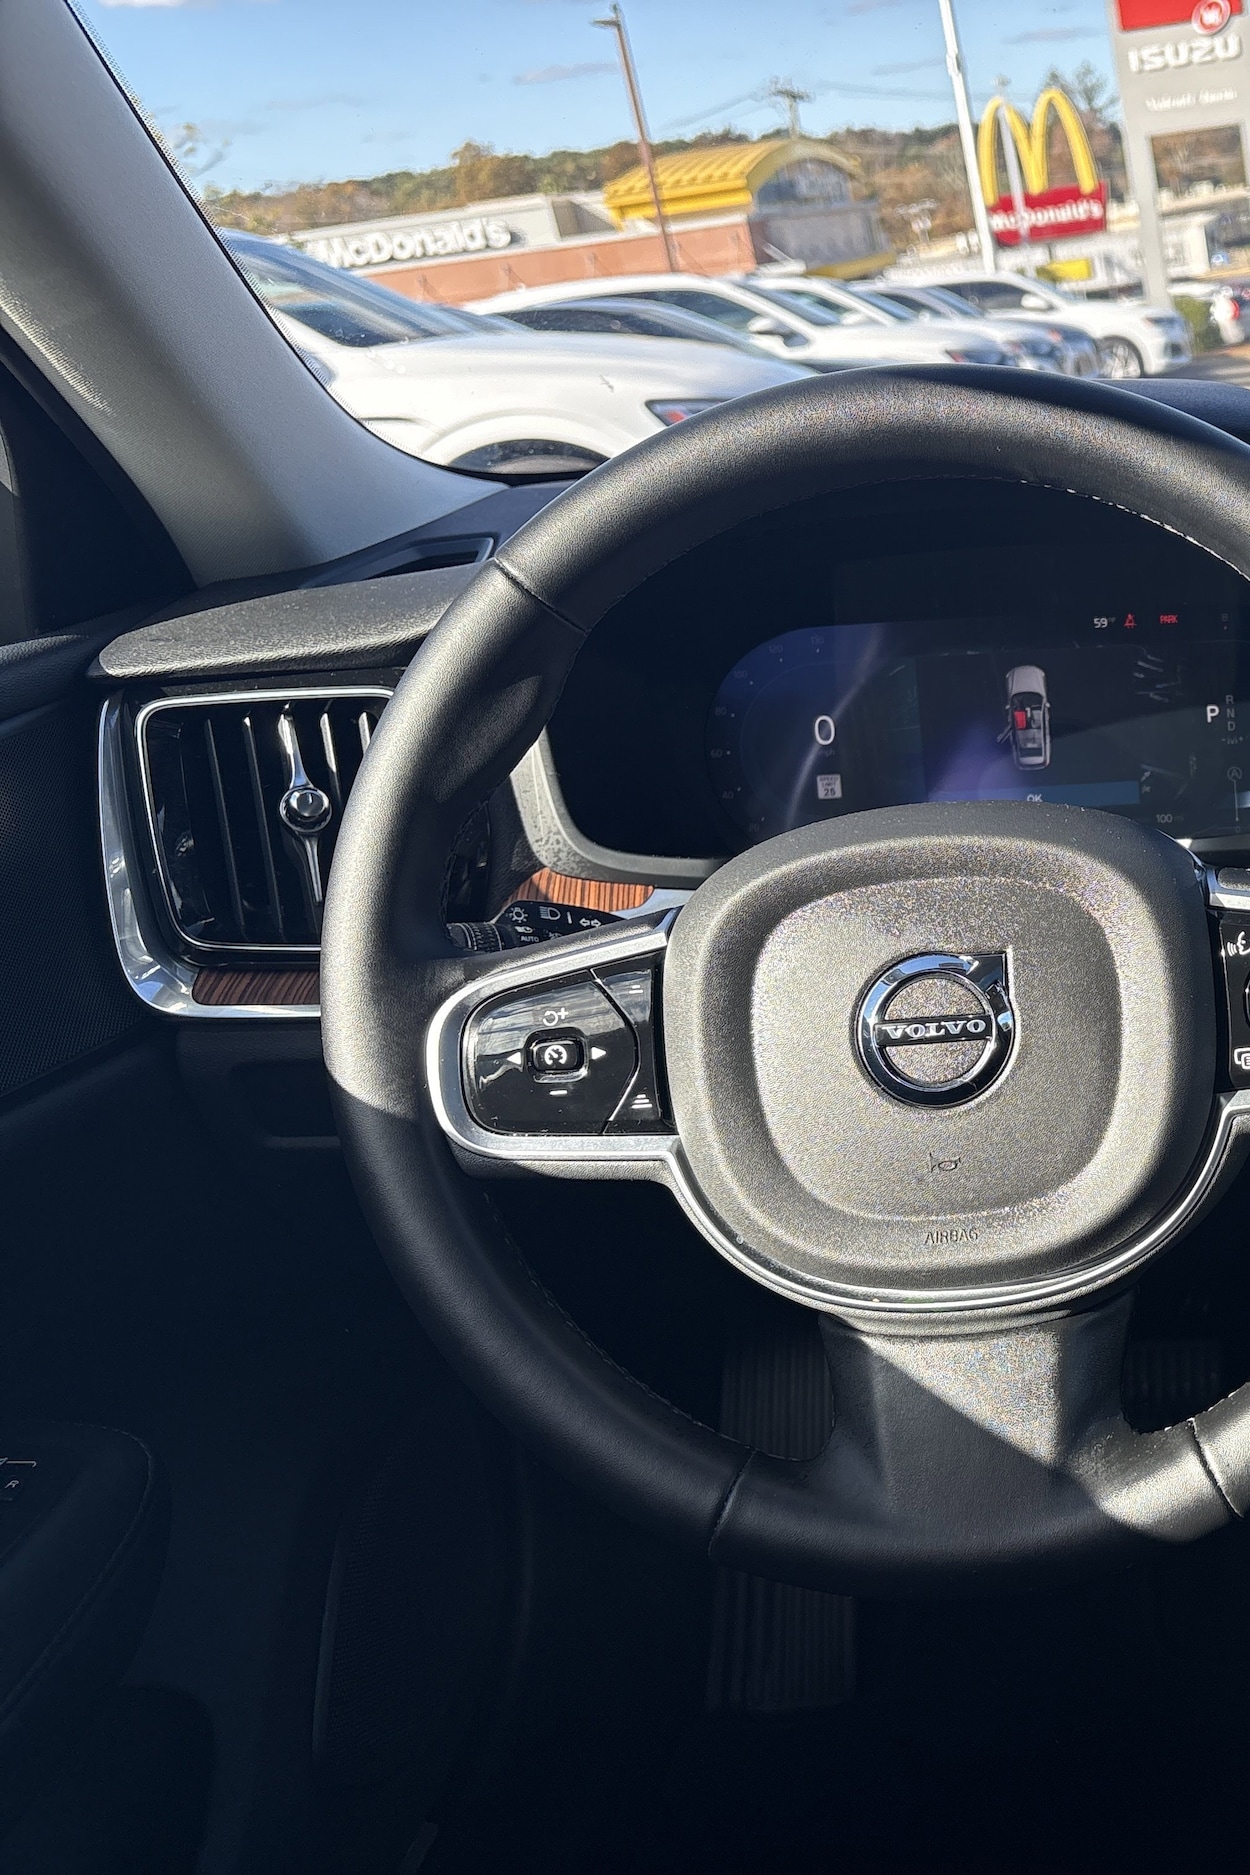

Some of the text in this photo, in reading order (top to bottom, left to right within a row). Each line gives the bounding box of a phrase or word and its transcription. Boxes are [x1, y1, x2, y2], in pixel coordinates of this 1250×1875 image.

[1127, 33, 1240, 72] ISUZU
[318, 217, 512, 268] McDonald's
[1206, 704, 1220, 723] P
[814, 715, 835, 746] 0
[823, 788, 836, 797] 25
[1027, 793, 1044, 803] OK
[520, 935, 540, 943] AUTO
[881, 1019, 987, 1040] VOLVO
[924, 1227, 979, 1245] AIRBAG
